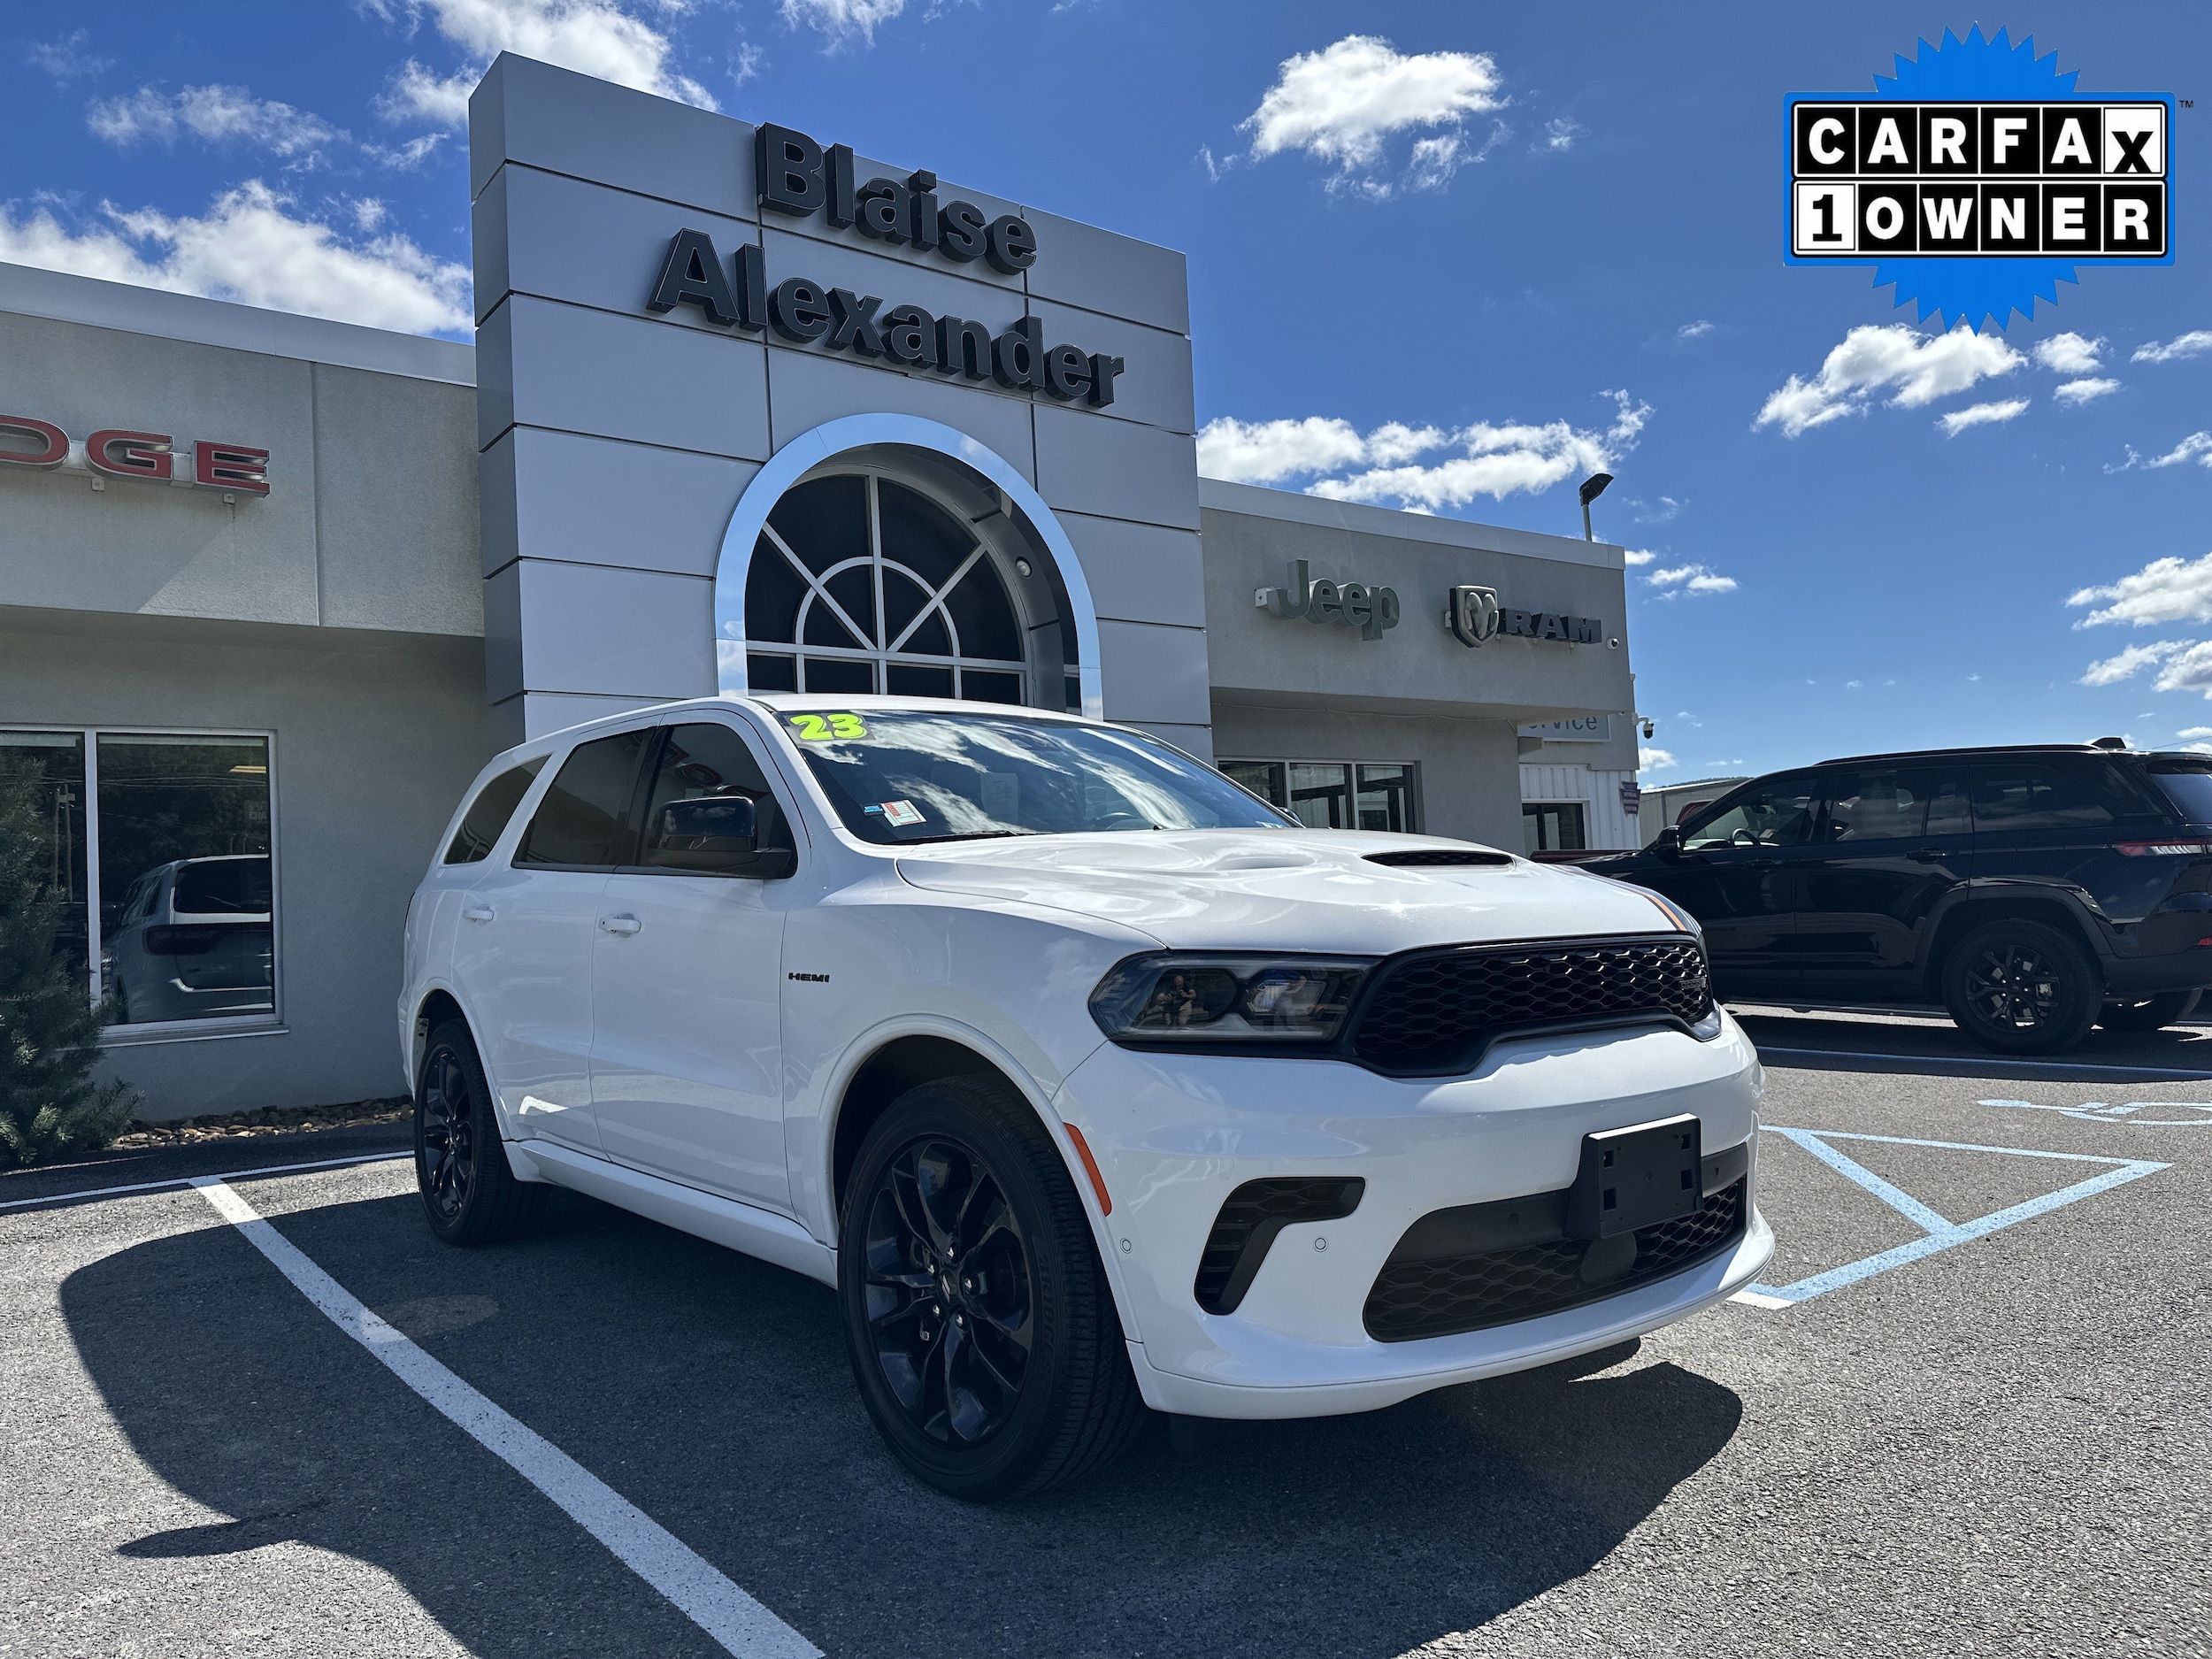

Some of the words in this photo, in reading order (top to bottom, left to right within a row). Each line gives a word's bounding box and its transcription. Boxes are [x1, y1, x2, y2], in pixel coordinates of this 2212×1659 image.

[755, 122, 1038, 275] Blaise
[647, 227, 1125, 409] Alexander
[1267, 558, 1401, 641] Jeep
[1501, 608, 1602, 645] RAM
[789, 713, 868, 741] 23
[787, 972, 830, 983] HEMI
